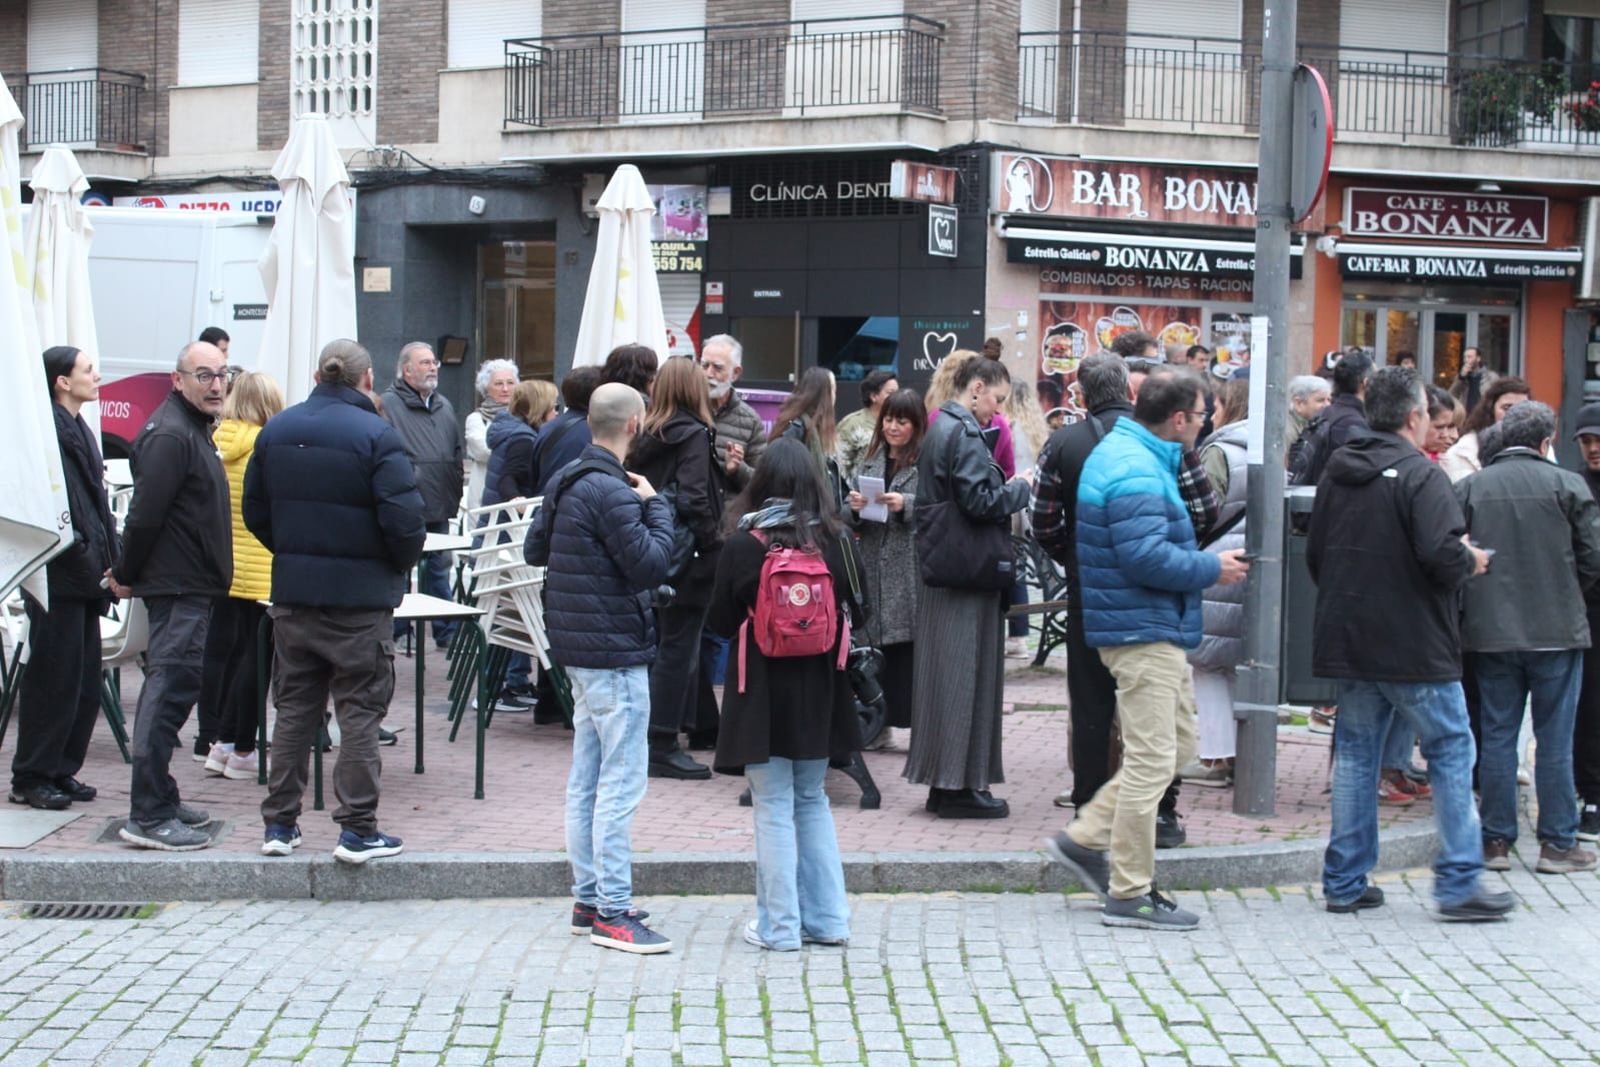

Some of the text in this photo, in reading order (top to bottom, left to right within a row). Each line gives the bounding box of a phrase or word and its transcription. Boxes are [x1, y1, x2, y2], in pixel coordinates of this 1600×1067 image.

[750, 181, 891, 201] CLÍNICA DENT
[1071, 169, 1258, 219] BAR BONA
[1386, 195, 1446, 213] CAFE
[1465, 200, 1511, 214] BAR
[1355, 210, 1542, 239] BONANZA
[679, 257, 703, 271] 754
[1105, 246, 1210, 273] BONANZA
[1347, 256, 1411, 274] CAFE-BAR
[1415, 257, 1487, 277] BONANZA
[1040, 270, 1253, 292] COMBINADOS TAPAS RACION
